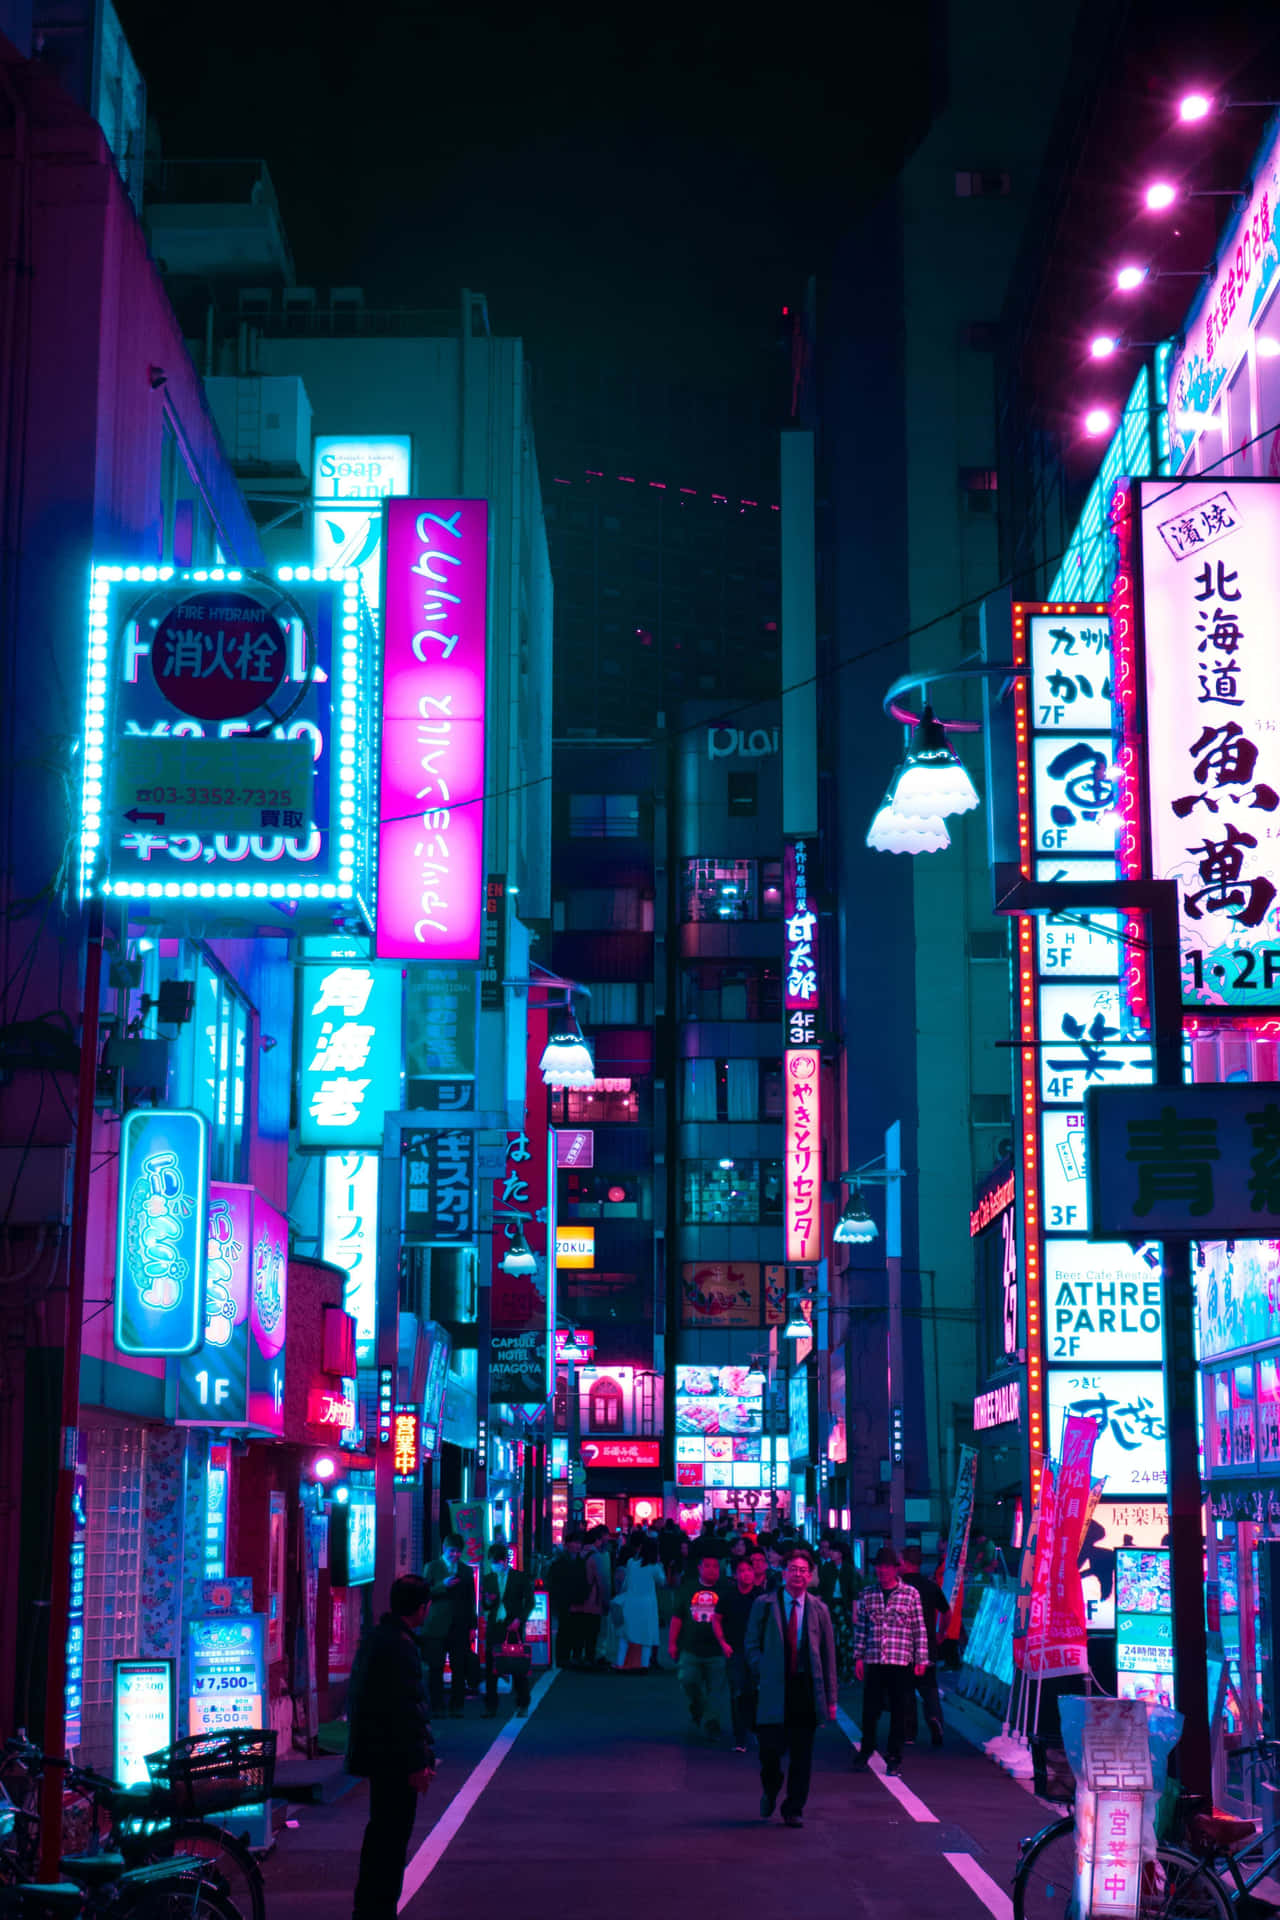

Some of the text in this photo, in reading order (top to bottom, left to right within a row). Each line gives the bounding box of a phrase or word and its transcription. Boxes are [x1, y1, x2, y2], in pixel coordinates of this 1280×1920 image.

[320, 455, 382, 482] Soap
[332, 477, 395, 497] Land
[411, 511, 463, 662] マックス
[177, 605, 267, 623] FIRE HYDRANT
[1194, 559, 1245, 706] 北海道
[163, 628, 278, 683] 消火栓
[1039, 705, 1064, 724] 7F
[260, 809, 302, 829] 買取
[413, 694, 453, 943] ファッションヘルス
[1171, 720, 1280, 928] 魚萬
[1041, 829, 1068, 848] 6F
[785, 911, 818, 1000] 甘太郎
[1046, 948, 1072, 967] 5F
[790, 1012, 815, 1026] 4F
[790, 1028, 815, 1043] 3F
[307, 967, 376, 1127] 角海老
[1047, 1077, 1074, 1097] 4F
[792, 1082, 819, 1259] やきとりセンター
[1051, 1206, 1077, 1225] 3F
[1056, 1270, 1080, 1280] Beer
[1056, 1309, 1161, 1333] PARLO
[491, 1337, 536, 1349] CAPSULE
[1054, 1337, 1080, 1357] 2F
[497, 1351, 529, 1362] HOTEL
[196, 1370, 230, 1405] 1F
[1067, 1377, 1101, 1389] つきじ
[395, 1415, 417, 1476] 営業中
[1104, 1808, 1131, 1902] 営業中
